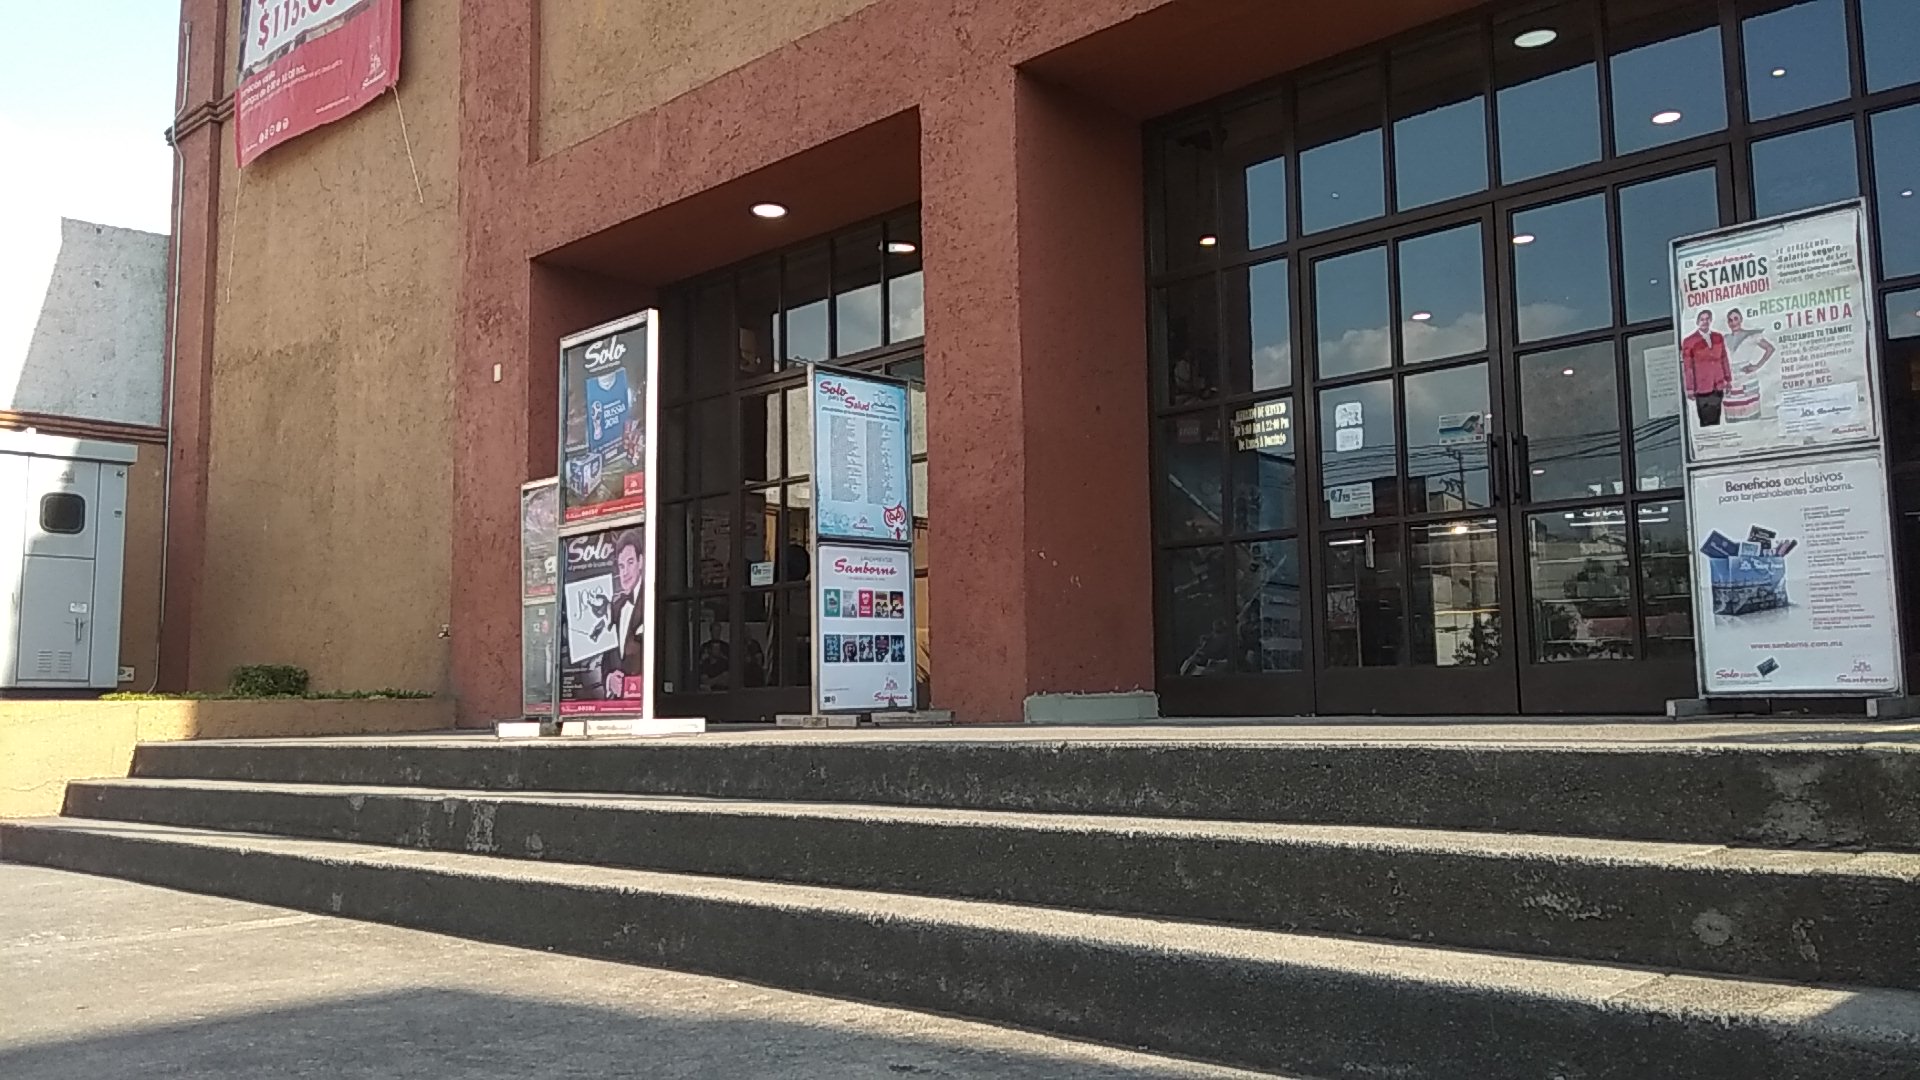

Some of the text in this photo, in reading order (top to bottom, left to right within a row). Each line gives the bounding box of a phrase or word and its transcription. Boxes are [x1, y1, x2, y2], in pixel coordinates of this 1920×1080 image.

[1683, 256, 1768, 293] ¡ESTAMOS
[1687, 277, 1770, 308] CONTRATANDO!
[1746, 284, 1851, 318] En RESTAURANTE
[1785, 302, 1853, 329] TIENDA
[584, 335, 627, 369] Solo
[819, 380, 849, 397] Solo
[1782, 379, 1805, 390] CURP
[844, 396, 870, 411] Salud
[1725, 471, 1844, 493] Beneficios exclusivos
[1718, 493, 1740, 505] para
[1740, 487, 1808, 503] tarjetahabientes
[568, 532, 615, 563] Solo
[834, 558, 898, 576] Sanborns
